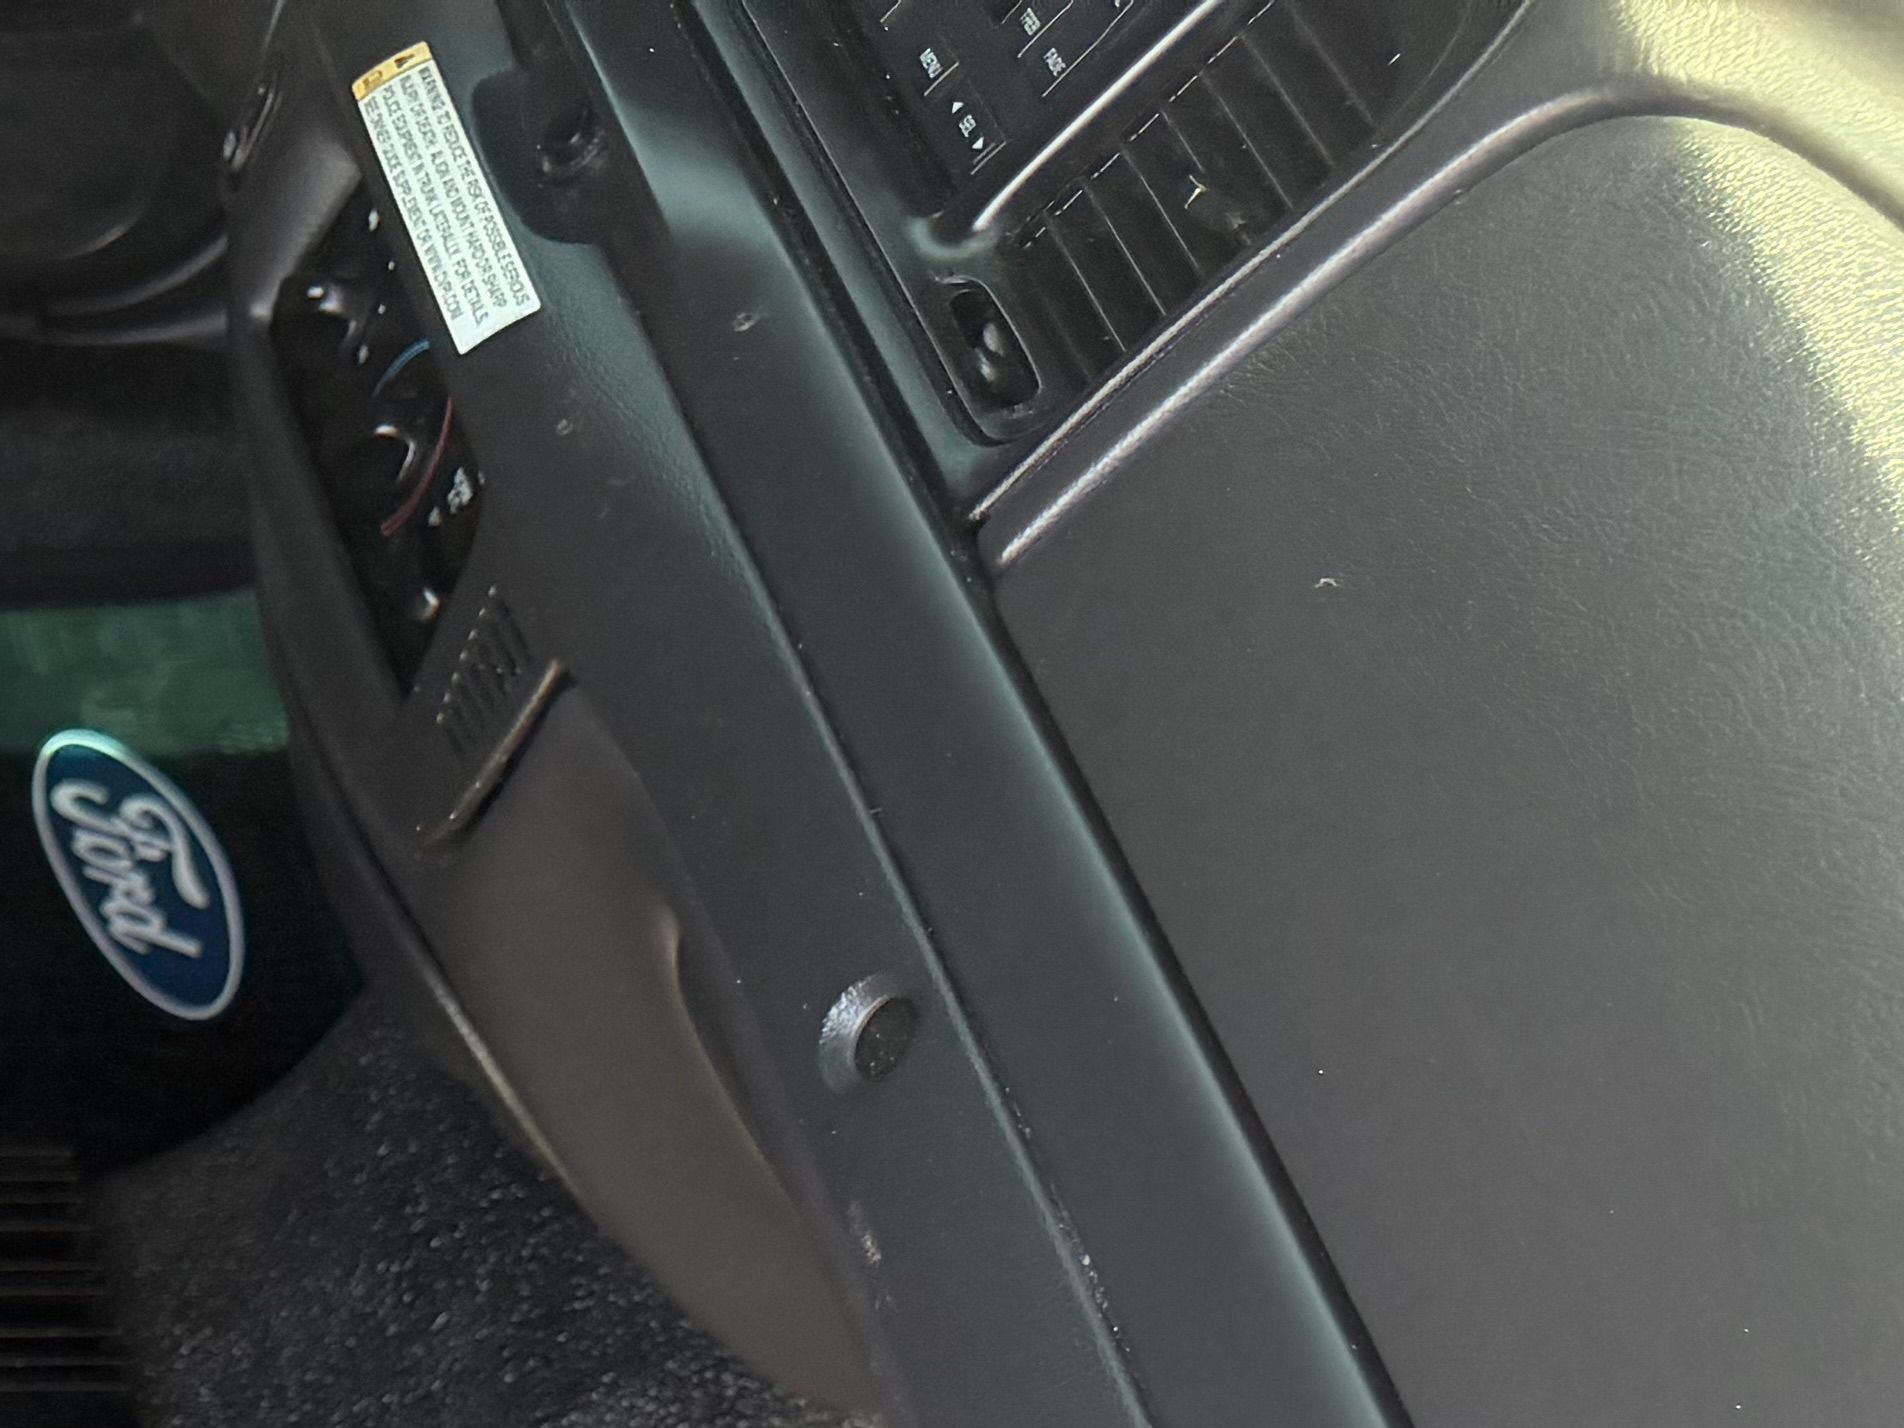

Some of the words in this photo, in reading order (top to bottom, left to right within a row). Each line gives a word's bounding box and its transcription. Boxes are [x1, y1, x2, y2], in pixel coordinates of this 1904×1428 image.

[919, 47, 943, 79] MENU
[1043, 46, 1067, 77] FADE
[958, 113, 977, 138] SEL
[49, 778, 209, 961] Ford
